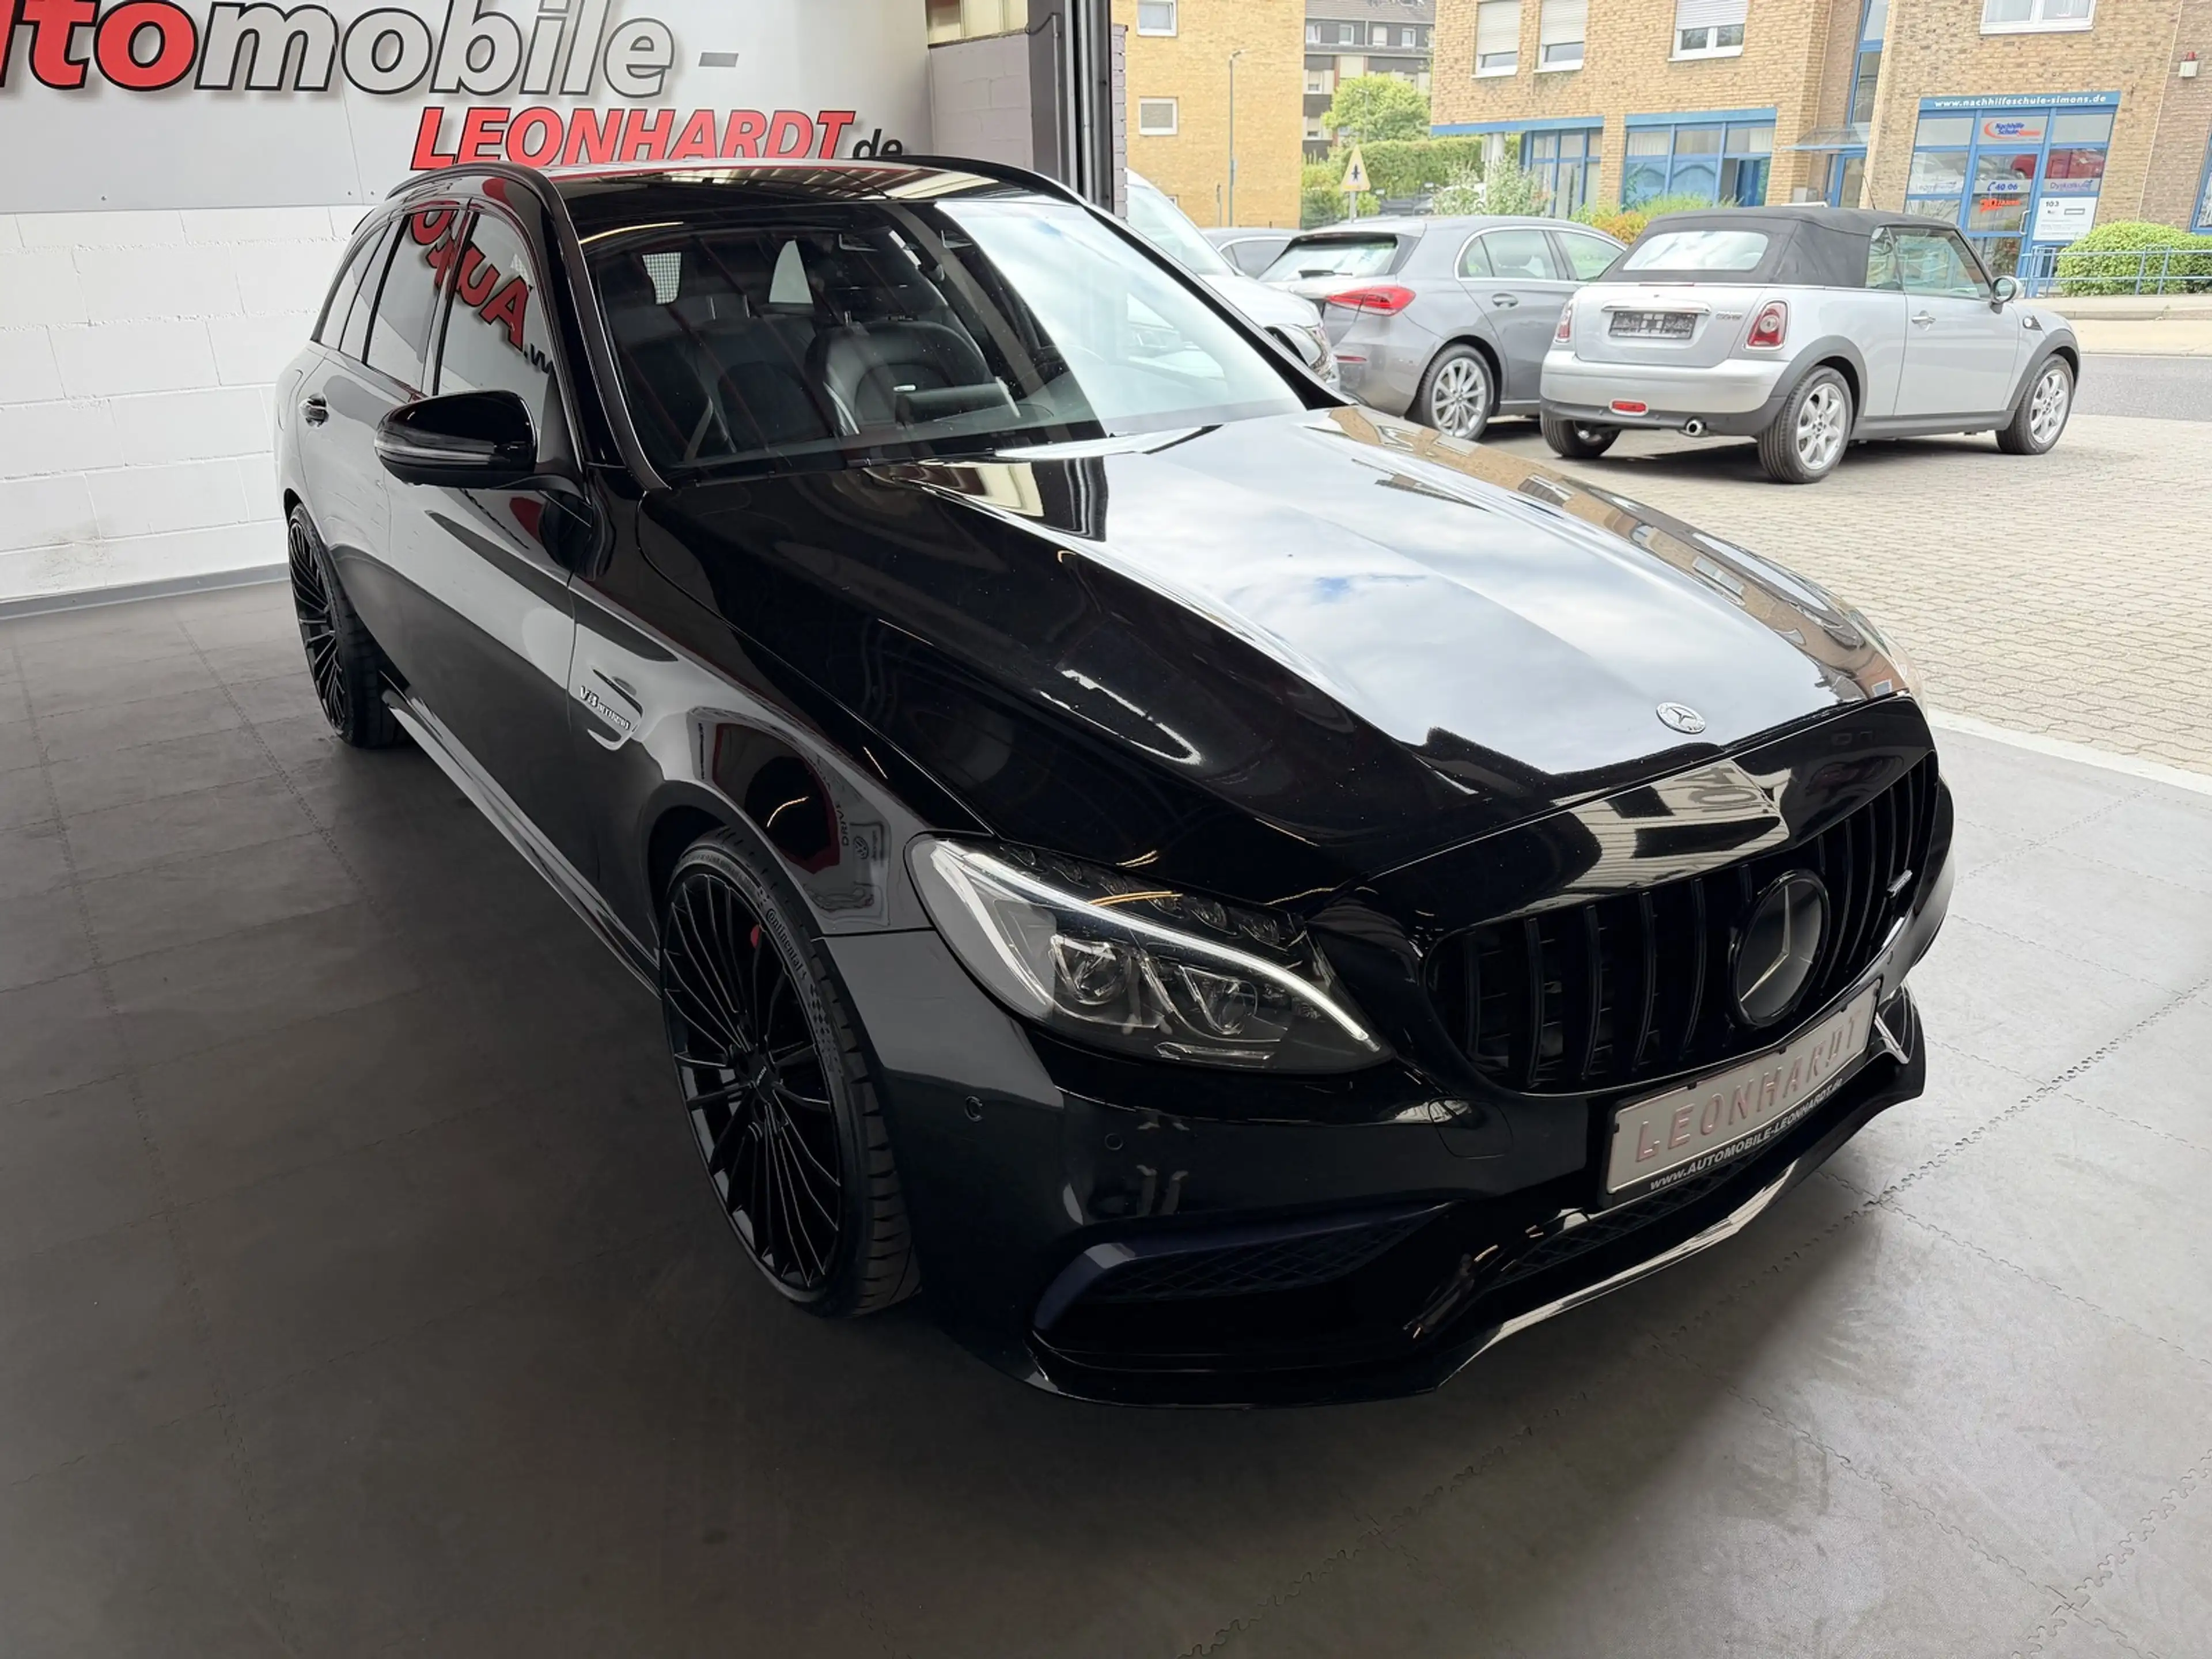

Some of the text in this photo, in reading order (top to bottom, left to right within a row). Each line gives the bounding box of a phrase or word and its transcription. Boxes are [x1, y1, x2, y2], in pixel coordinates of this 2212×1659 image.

[580, 685, 600, 708] V8
[766, 908, 804, 972] Continental
[1635, 1010, 1862, 1163] LEONHARDT
